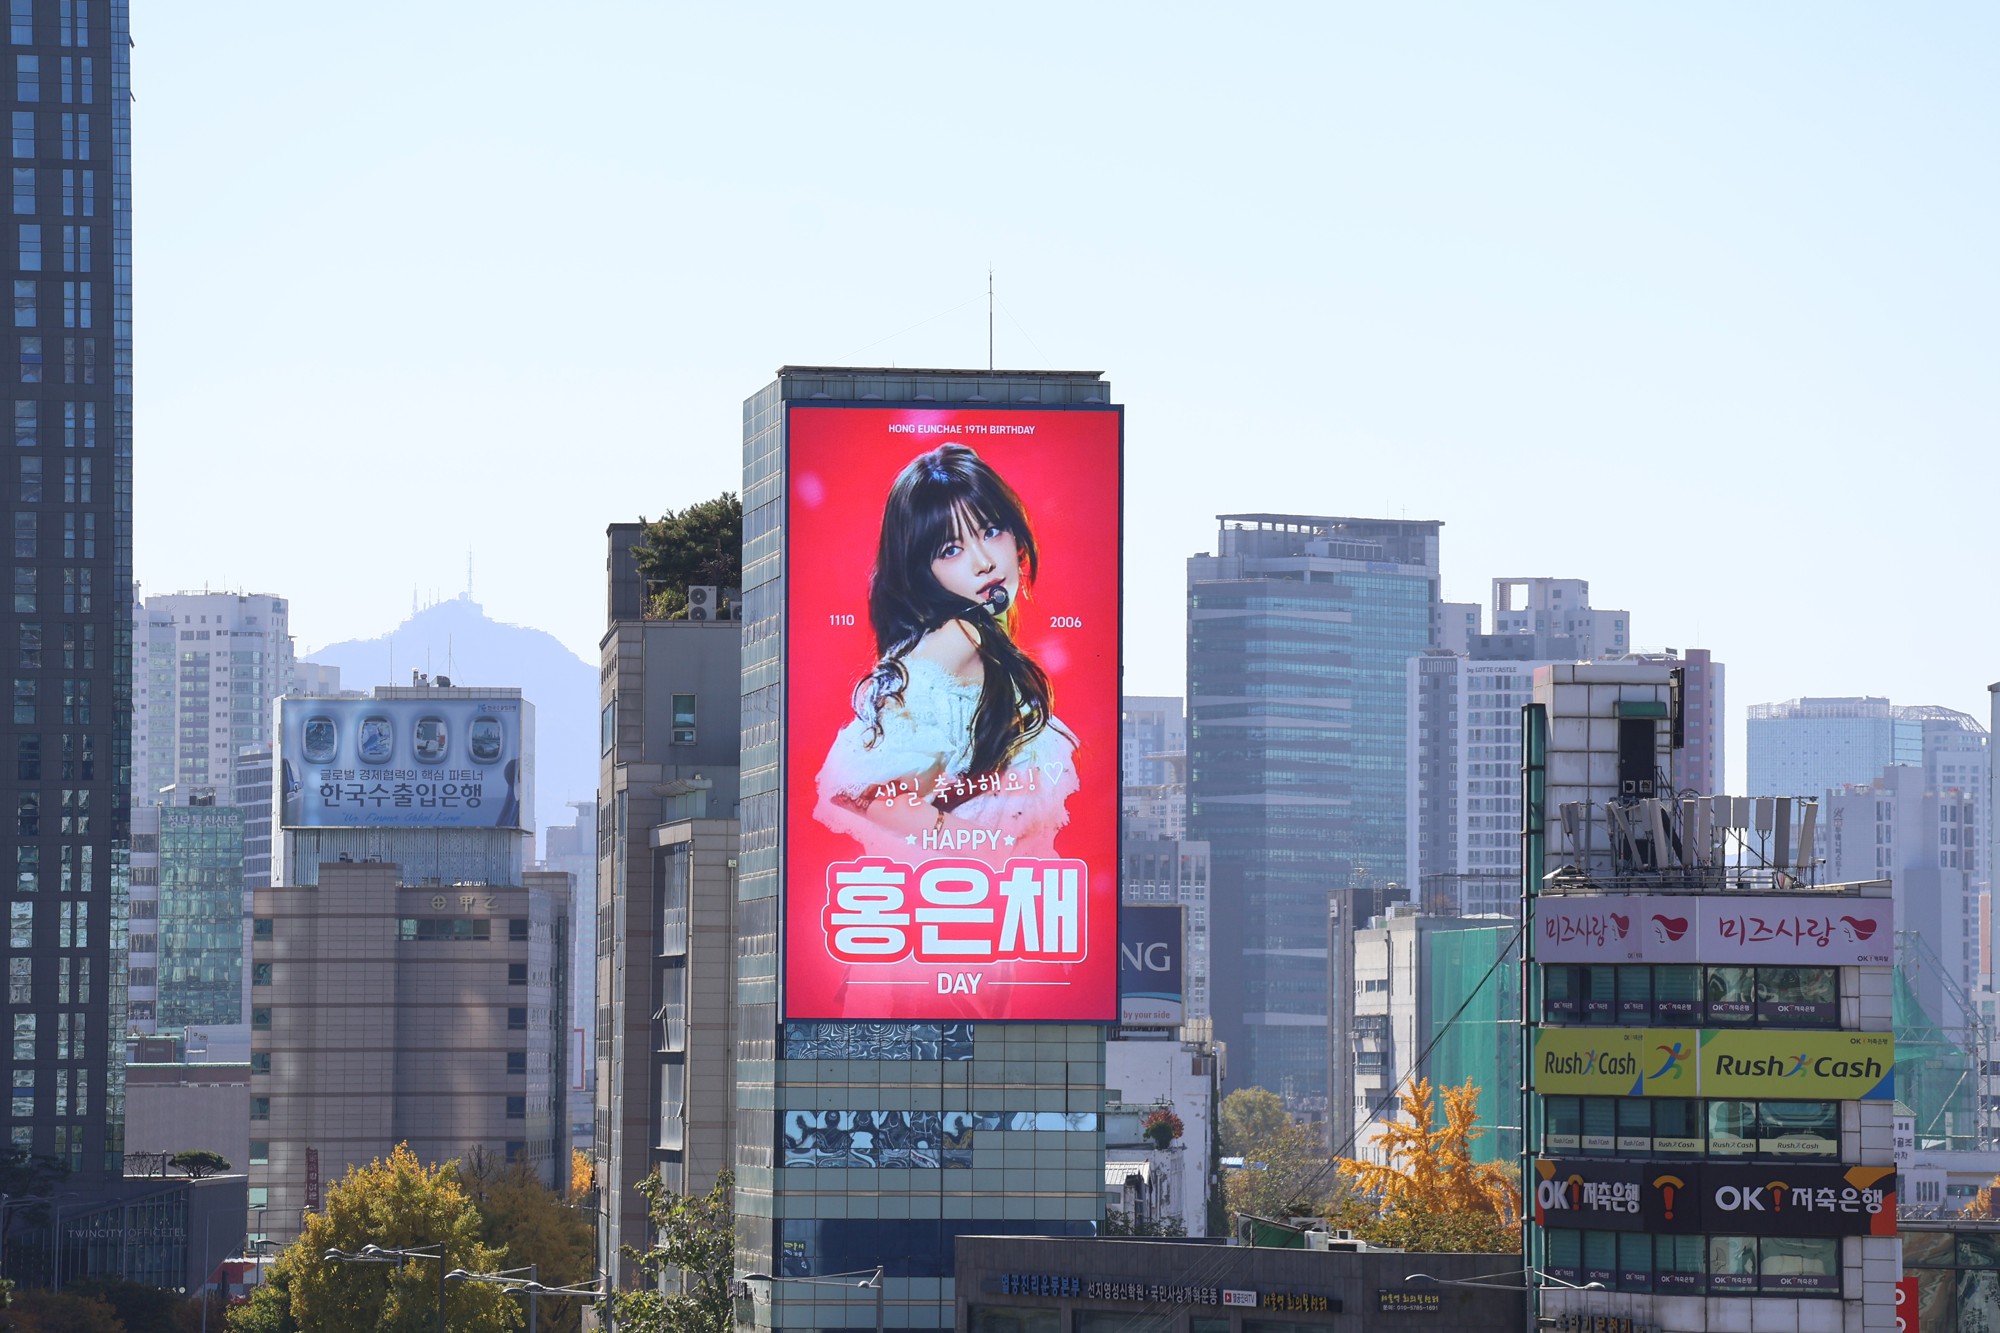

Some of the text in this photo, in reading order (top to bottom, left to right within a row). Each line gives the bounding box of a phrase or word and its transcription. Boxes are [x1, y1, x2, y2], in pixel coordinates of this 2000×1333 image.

[888, 424, 1036, 435] HONG EUNCHAE 19TH BIRTHDAY
[829, 614, 855, 626] 1110
[1050, 616, 1082, 628] 2006
[320, 769, 483, 781] 글로벌 경제협력의 핵심 파트너
[320, 783, 483, 809] 한국수출입은행
[875, 769, 1036, 808] 생일 축하해요!
[922, 829, 1002, 850] HAPPY
[830, 866, 1078, 955] 홍은채
[1546, 913, 1608, 947] 미즈사랑
[1719, 915, 1836, 947] 미즈사랑
[936, 973, 983, 994] DAY
[1123, 1010, 1133, 1019] by
[1659, 1003, 1668, 1011] OK
[1545, 1051, 1636, 1075] Rush Cash
[1716, 1055, 1881, 1078] Rush Cash
[1712, 1141, 1730, 1149] Rush
[1538, 1180, 1640, 1213] OK 저축은행
[1715, 1185, 1883, 1214] OK 저축은행
[68, 1227, 187, 1238] TWINCITY OFFICETEL
